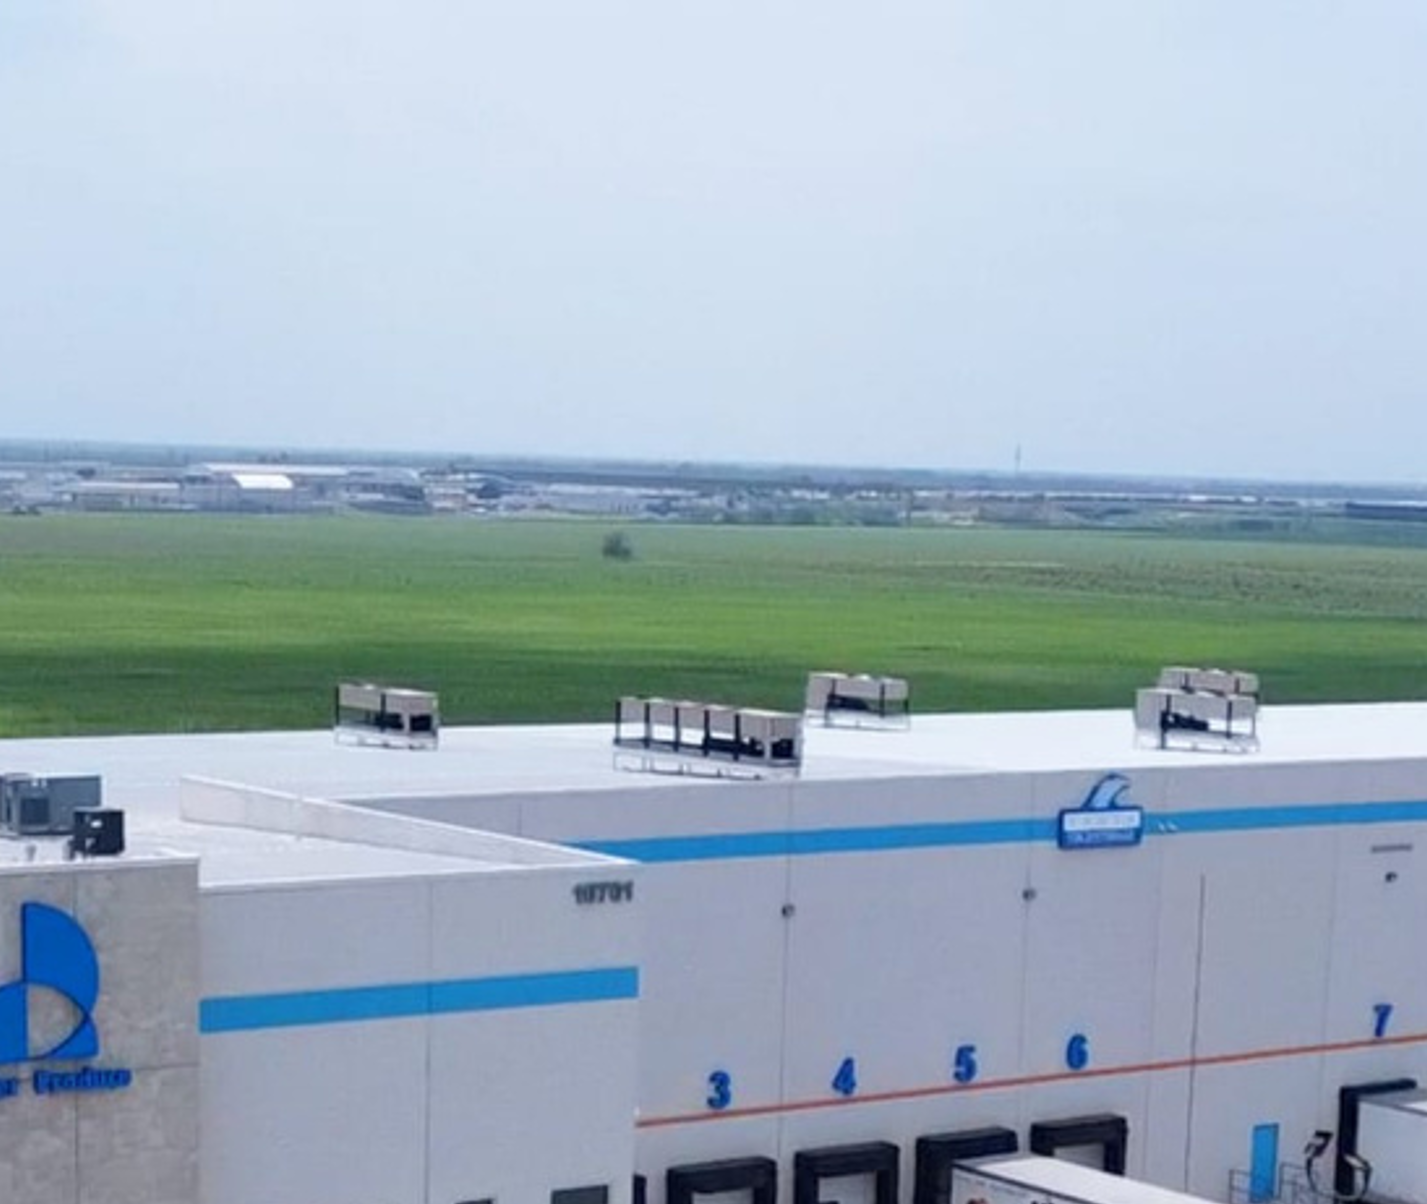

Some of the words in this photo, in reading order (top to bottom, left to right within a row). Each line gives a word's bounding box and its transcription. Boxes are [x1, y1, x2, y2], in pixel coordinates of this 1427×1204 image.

[1373, 1003, 1392, 1036] 7
[953, 1045, 977, 1082] 5
[1065, 1033, 1088, 1070] 6
[707, 1070, 731, 1109] 3
[832, 1057, 857, 1096] 4
